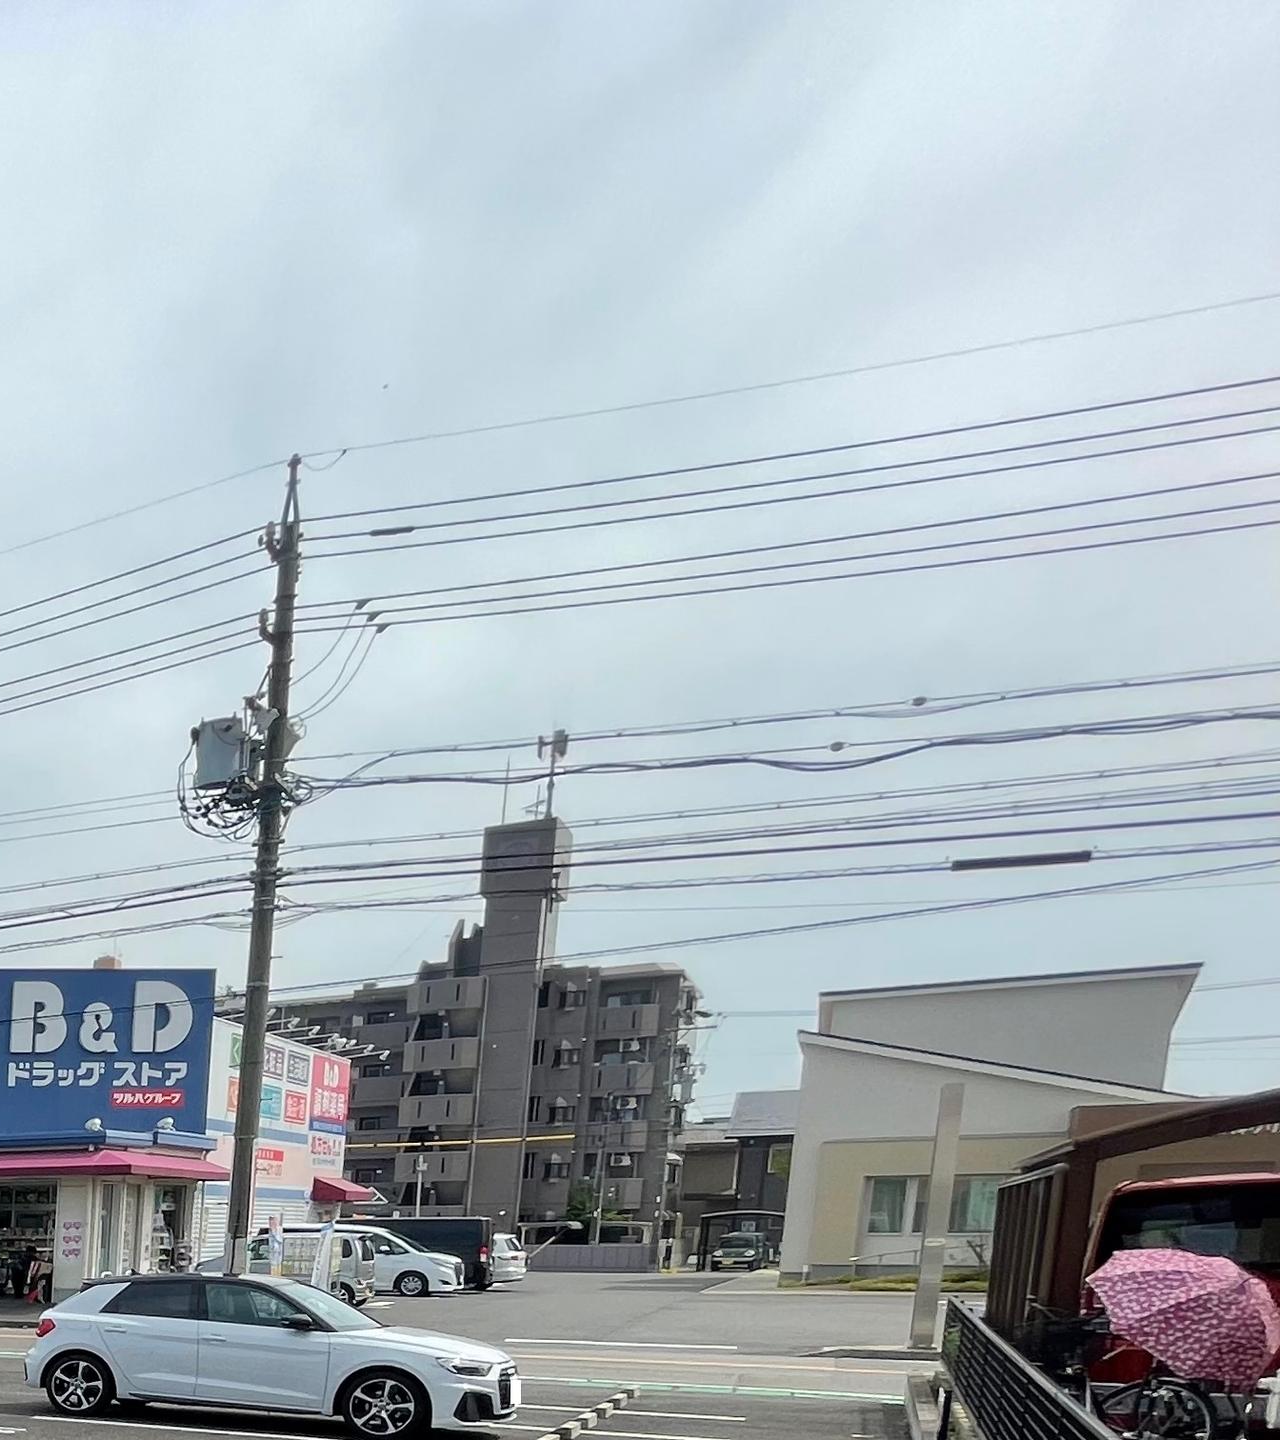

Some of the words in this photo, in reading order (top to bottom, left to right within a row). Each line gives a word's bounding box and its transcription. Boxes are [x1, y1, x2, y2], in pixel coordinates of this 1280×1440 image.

[9, 980, 193, 1053] B&D
[112, 1093, 182, 1106] ツルハグループ
